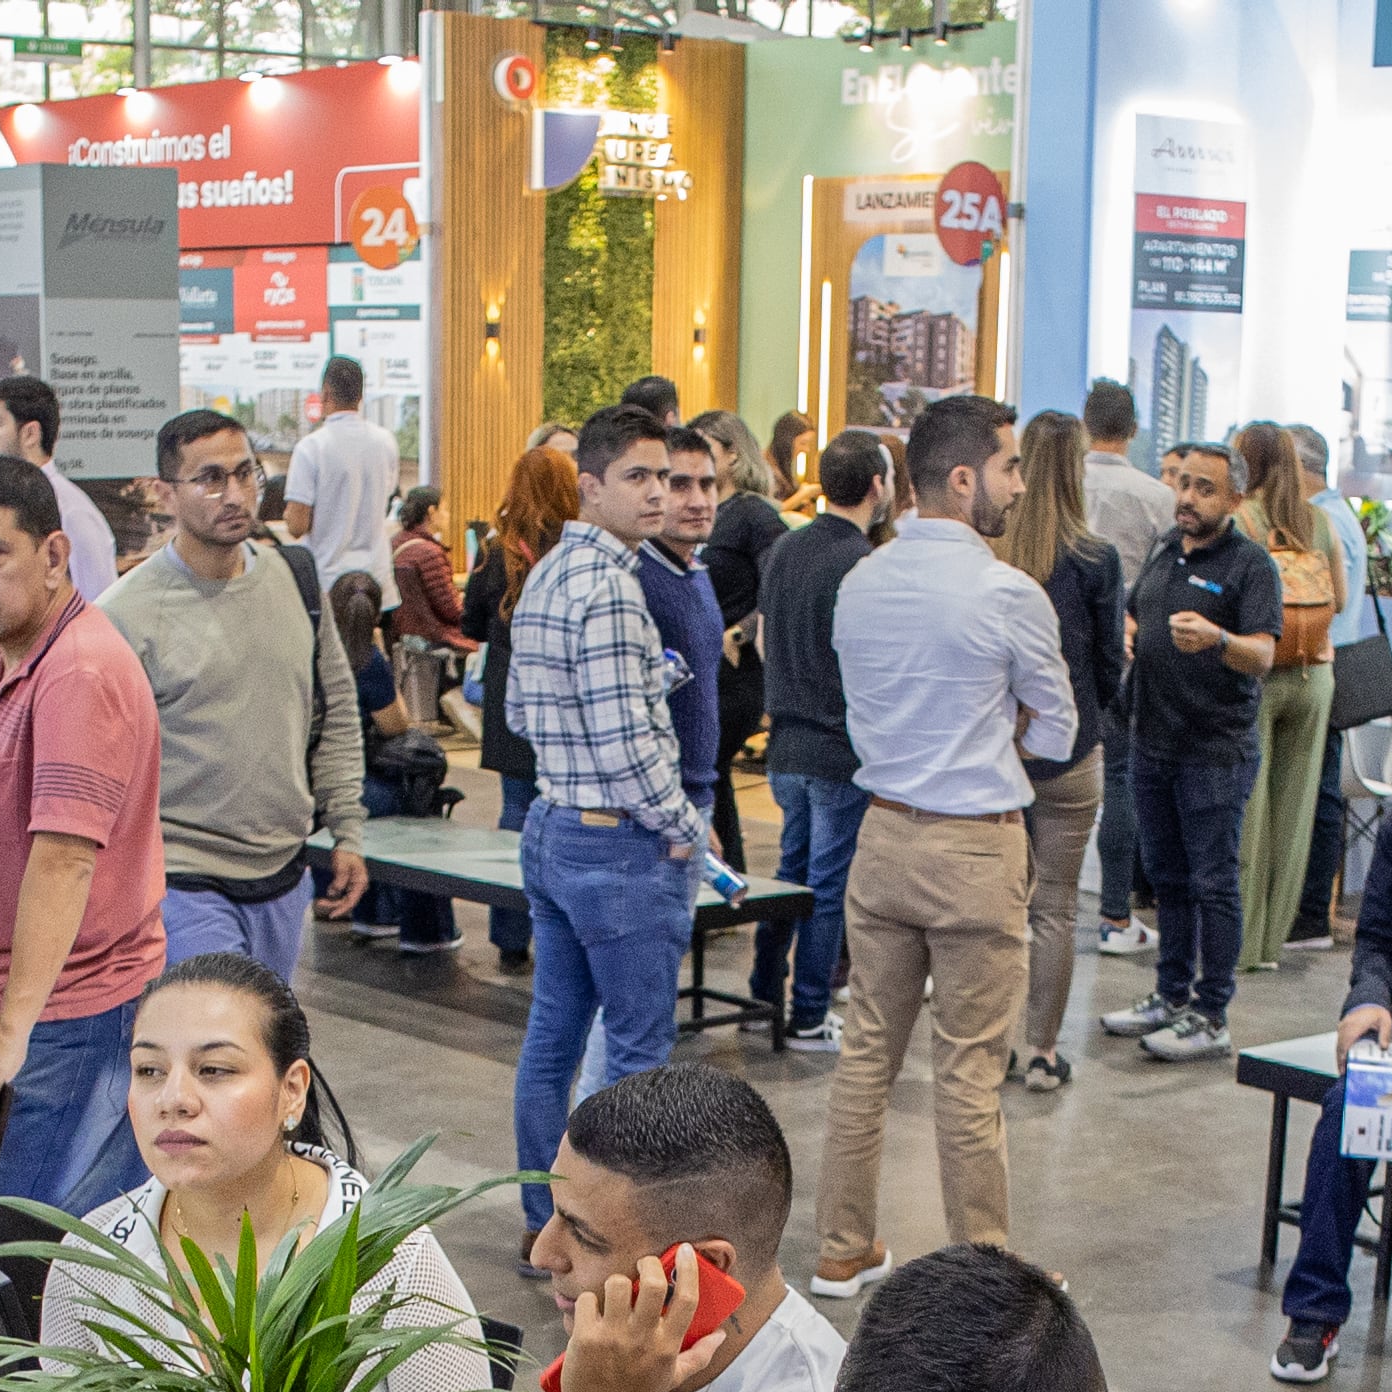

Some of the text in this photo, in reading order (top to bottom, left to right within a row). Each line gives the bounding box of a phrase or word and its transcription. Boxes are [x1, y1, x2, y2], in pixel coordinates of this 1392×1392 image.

[209, 125, 231, 160] el
[201, 170, 294, 207] sueños!
[360, 208, 407, 246] 24
[939, 190, 1002, 233] 25A
